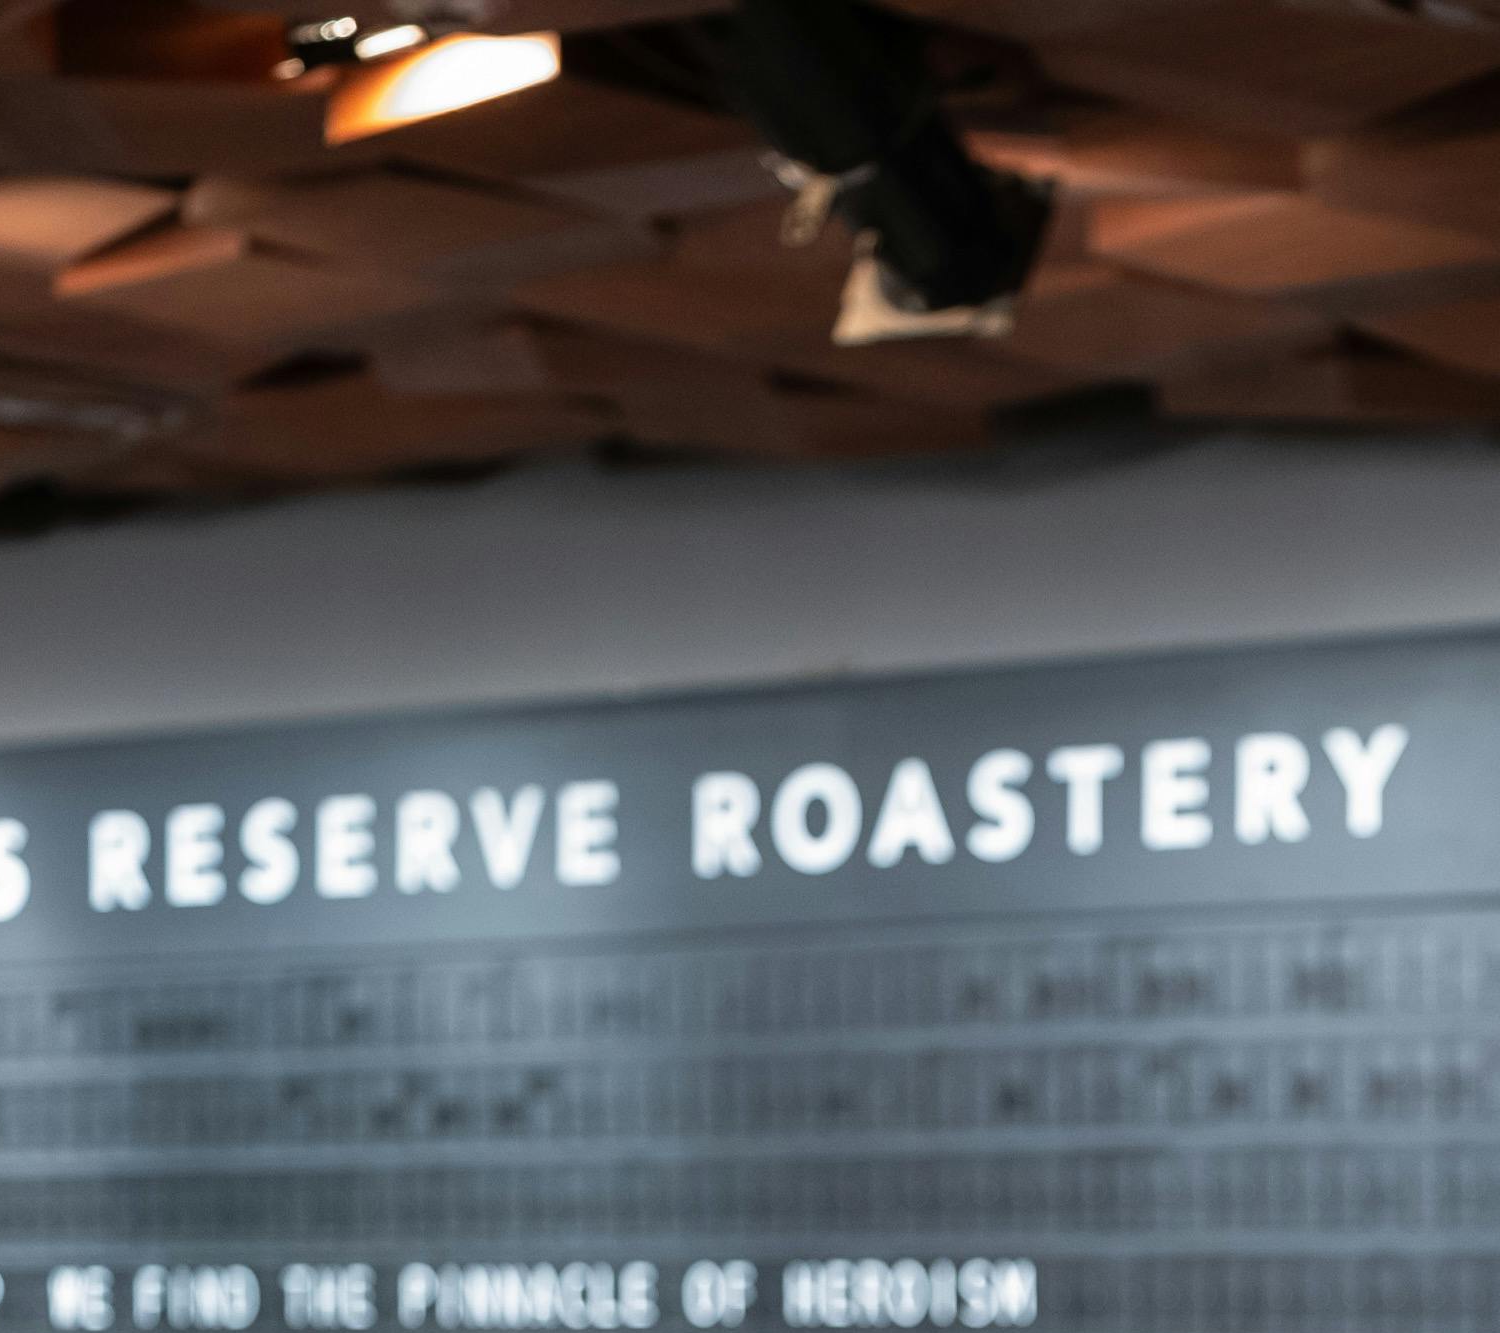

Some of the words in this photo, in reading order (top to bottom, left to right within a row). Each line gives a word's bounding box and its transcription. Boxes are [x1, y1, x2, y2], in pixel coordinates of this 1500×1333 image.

[89, 781, 621, 912] RESERVE
[691, 723, 1410, 880] ROASTERY
[48, 1266, 109, 1330] WE
[133, 1264, 259, 1329] FIND
[283, 1263, 373, 1329] THE
[399, 1261, 654, 1329] PINNACLE
[682, 1260, 753, 1327] OF
[784, 1259, 1037, 1327] HEROISM
